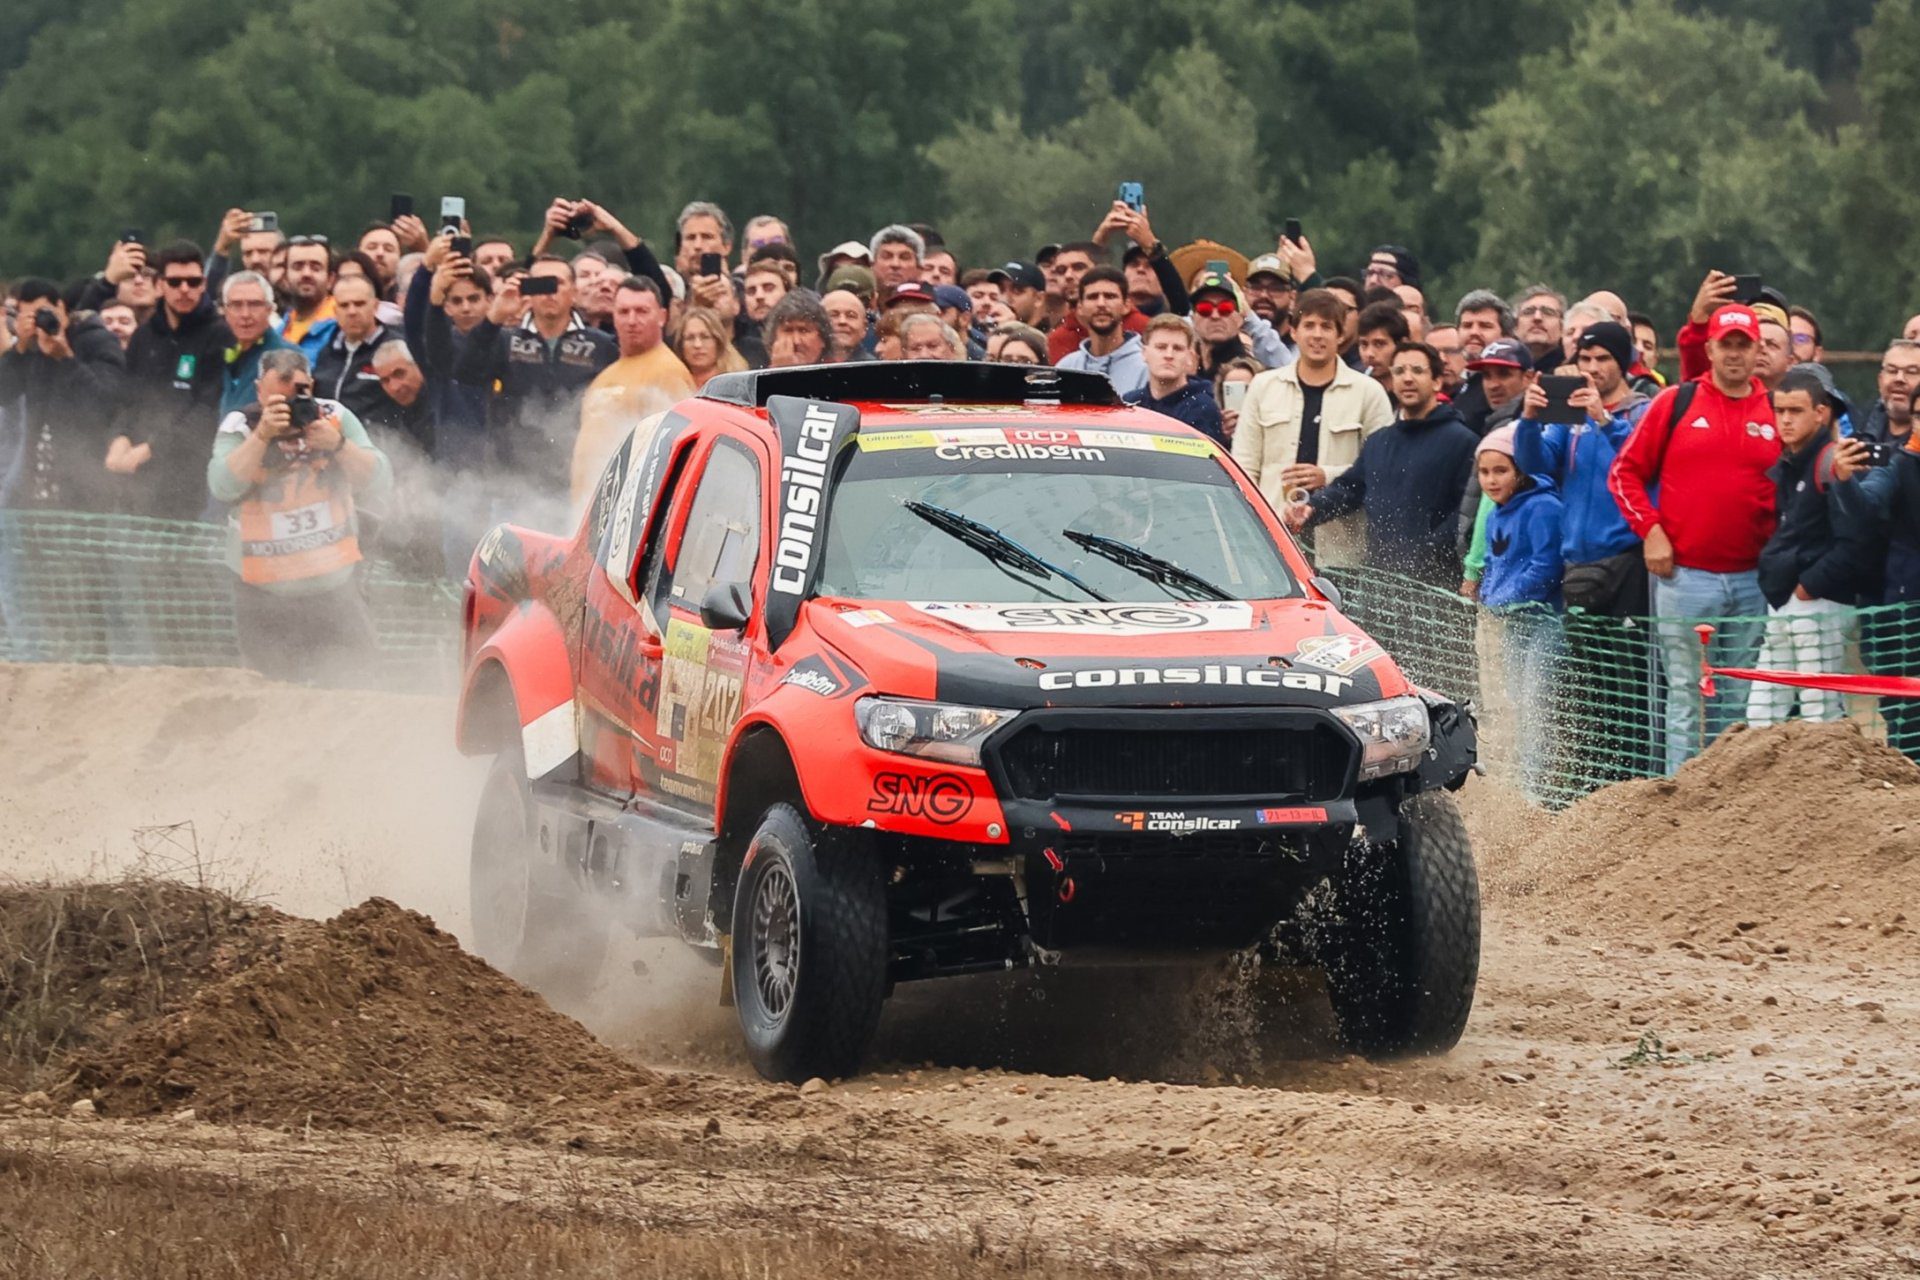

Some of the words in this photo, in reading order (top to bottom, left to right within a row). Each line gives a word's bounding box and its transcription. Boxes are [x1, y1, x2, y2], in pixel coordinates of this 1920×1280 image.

[1015, 430, 1069, 443] acp
[934, 443, 1106, 462] Credibom
[773, 404, 838, 595] consilcar
[284, 508, 318, 535] 33
[998, 606, 1209, 628] SNG
[1039, 665, 1354, 698] consilcar
[702, 670, 742, 736] 202
[867, 772, 974, 825] SNG
[1147, 817, 1241, 831] consilcar
[1149, 811, 1185, 820] TEAM
